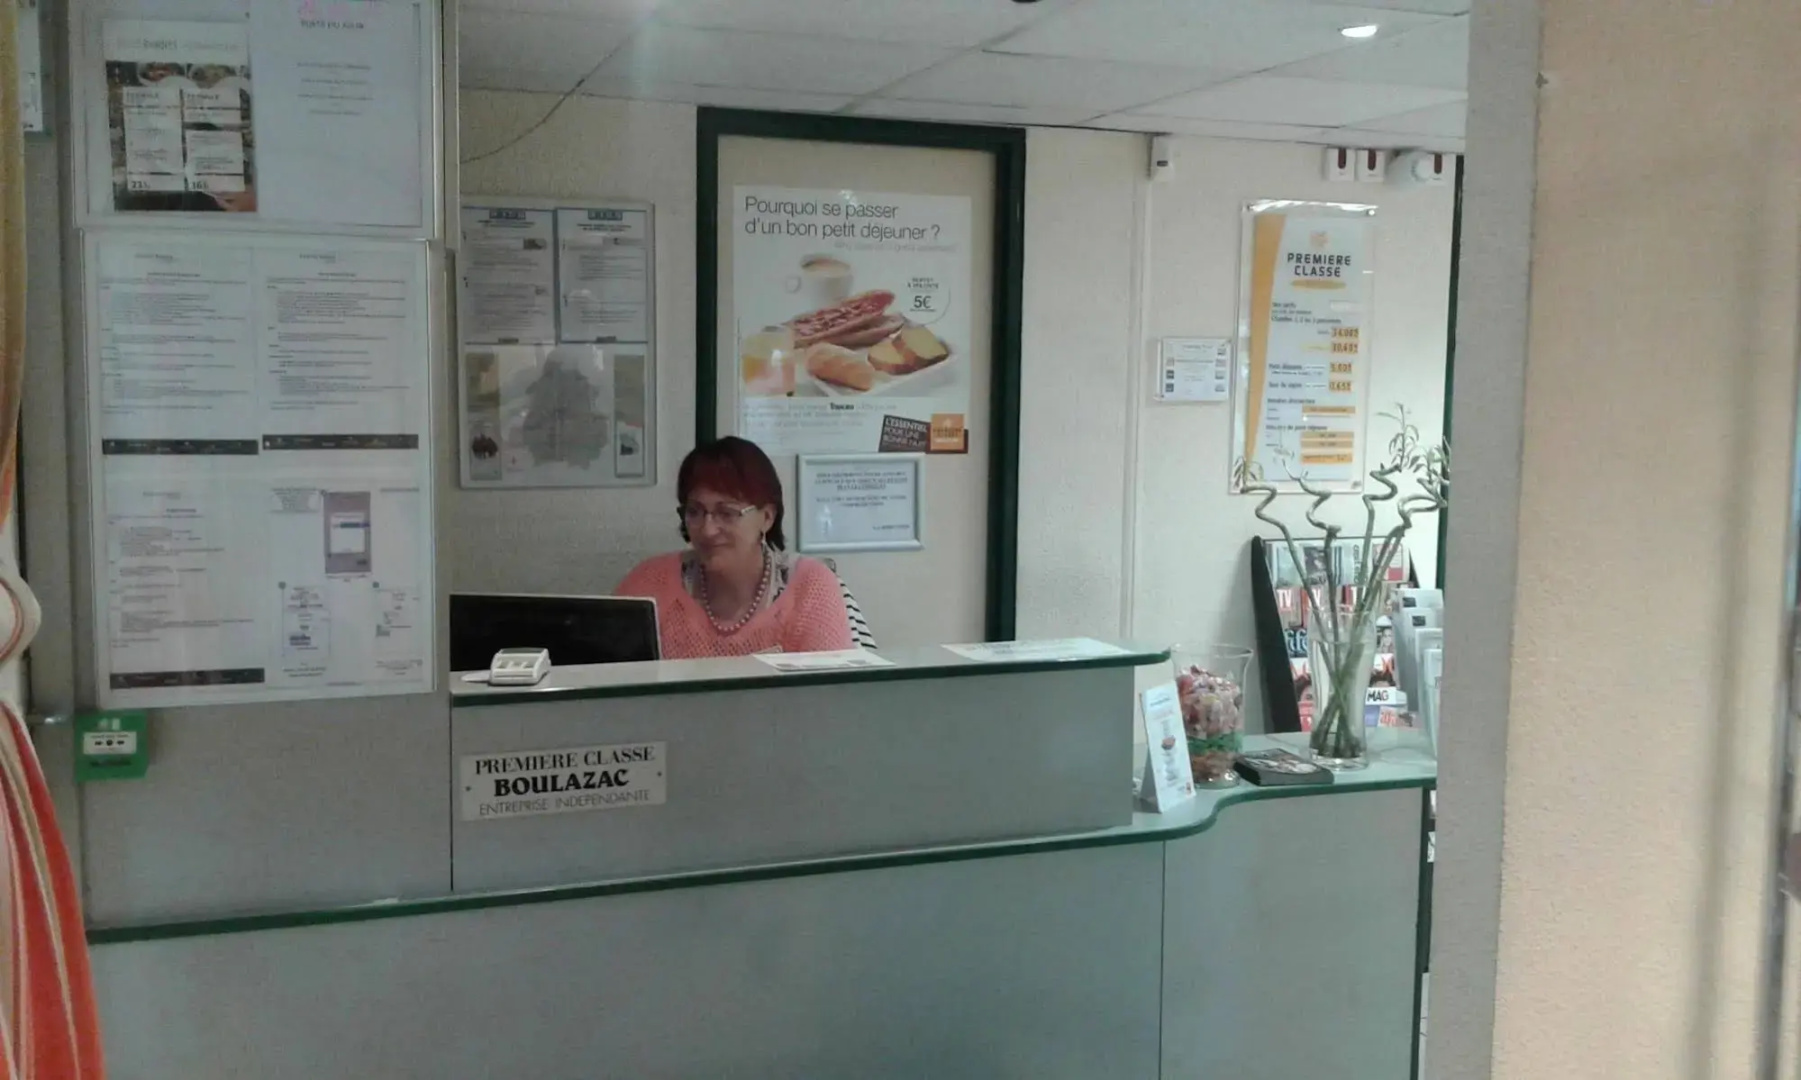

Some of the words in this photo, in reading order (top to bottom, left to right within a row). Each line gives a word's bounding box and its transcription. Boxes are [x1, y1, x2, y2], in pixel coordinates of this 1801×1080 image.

[745, 196, 817, 217] Pourquoi
[823, 202, 842, 217] se
[845, 202, 899, 220] passer
[744, 217, 782, 236] d'un
[786, 219, 817, 237] bon
[822, 221, 856, 240] petit
[930, 224, 941, 239] ?
[1287, 252, 1352, 267] PREMIERE
[1294, 264, 1342, 278] CLASSE
[914, 295, 932, 309] 5€
[1277, 589, 1292, 607] TV
[1366, 689, 1389, 702] MAG
[475, 752, 579, 775] PREMIERE
[583, 746, 656, 767] CLASSE
[494, 769, 630, 797] BOULAZAC
[479, 798, 549, 816] ENTREPRISE
[555, 789, 650, 809] INDEPENDANTE
